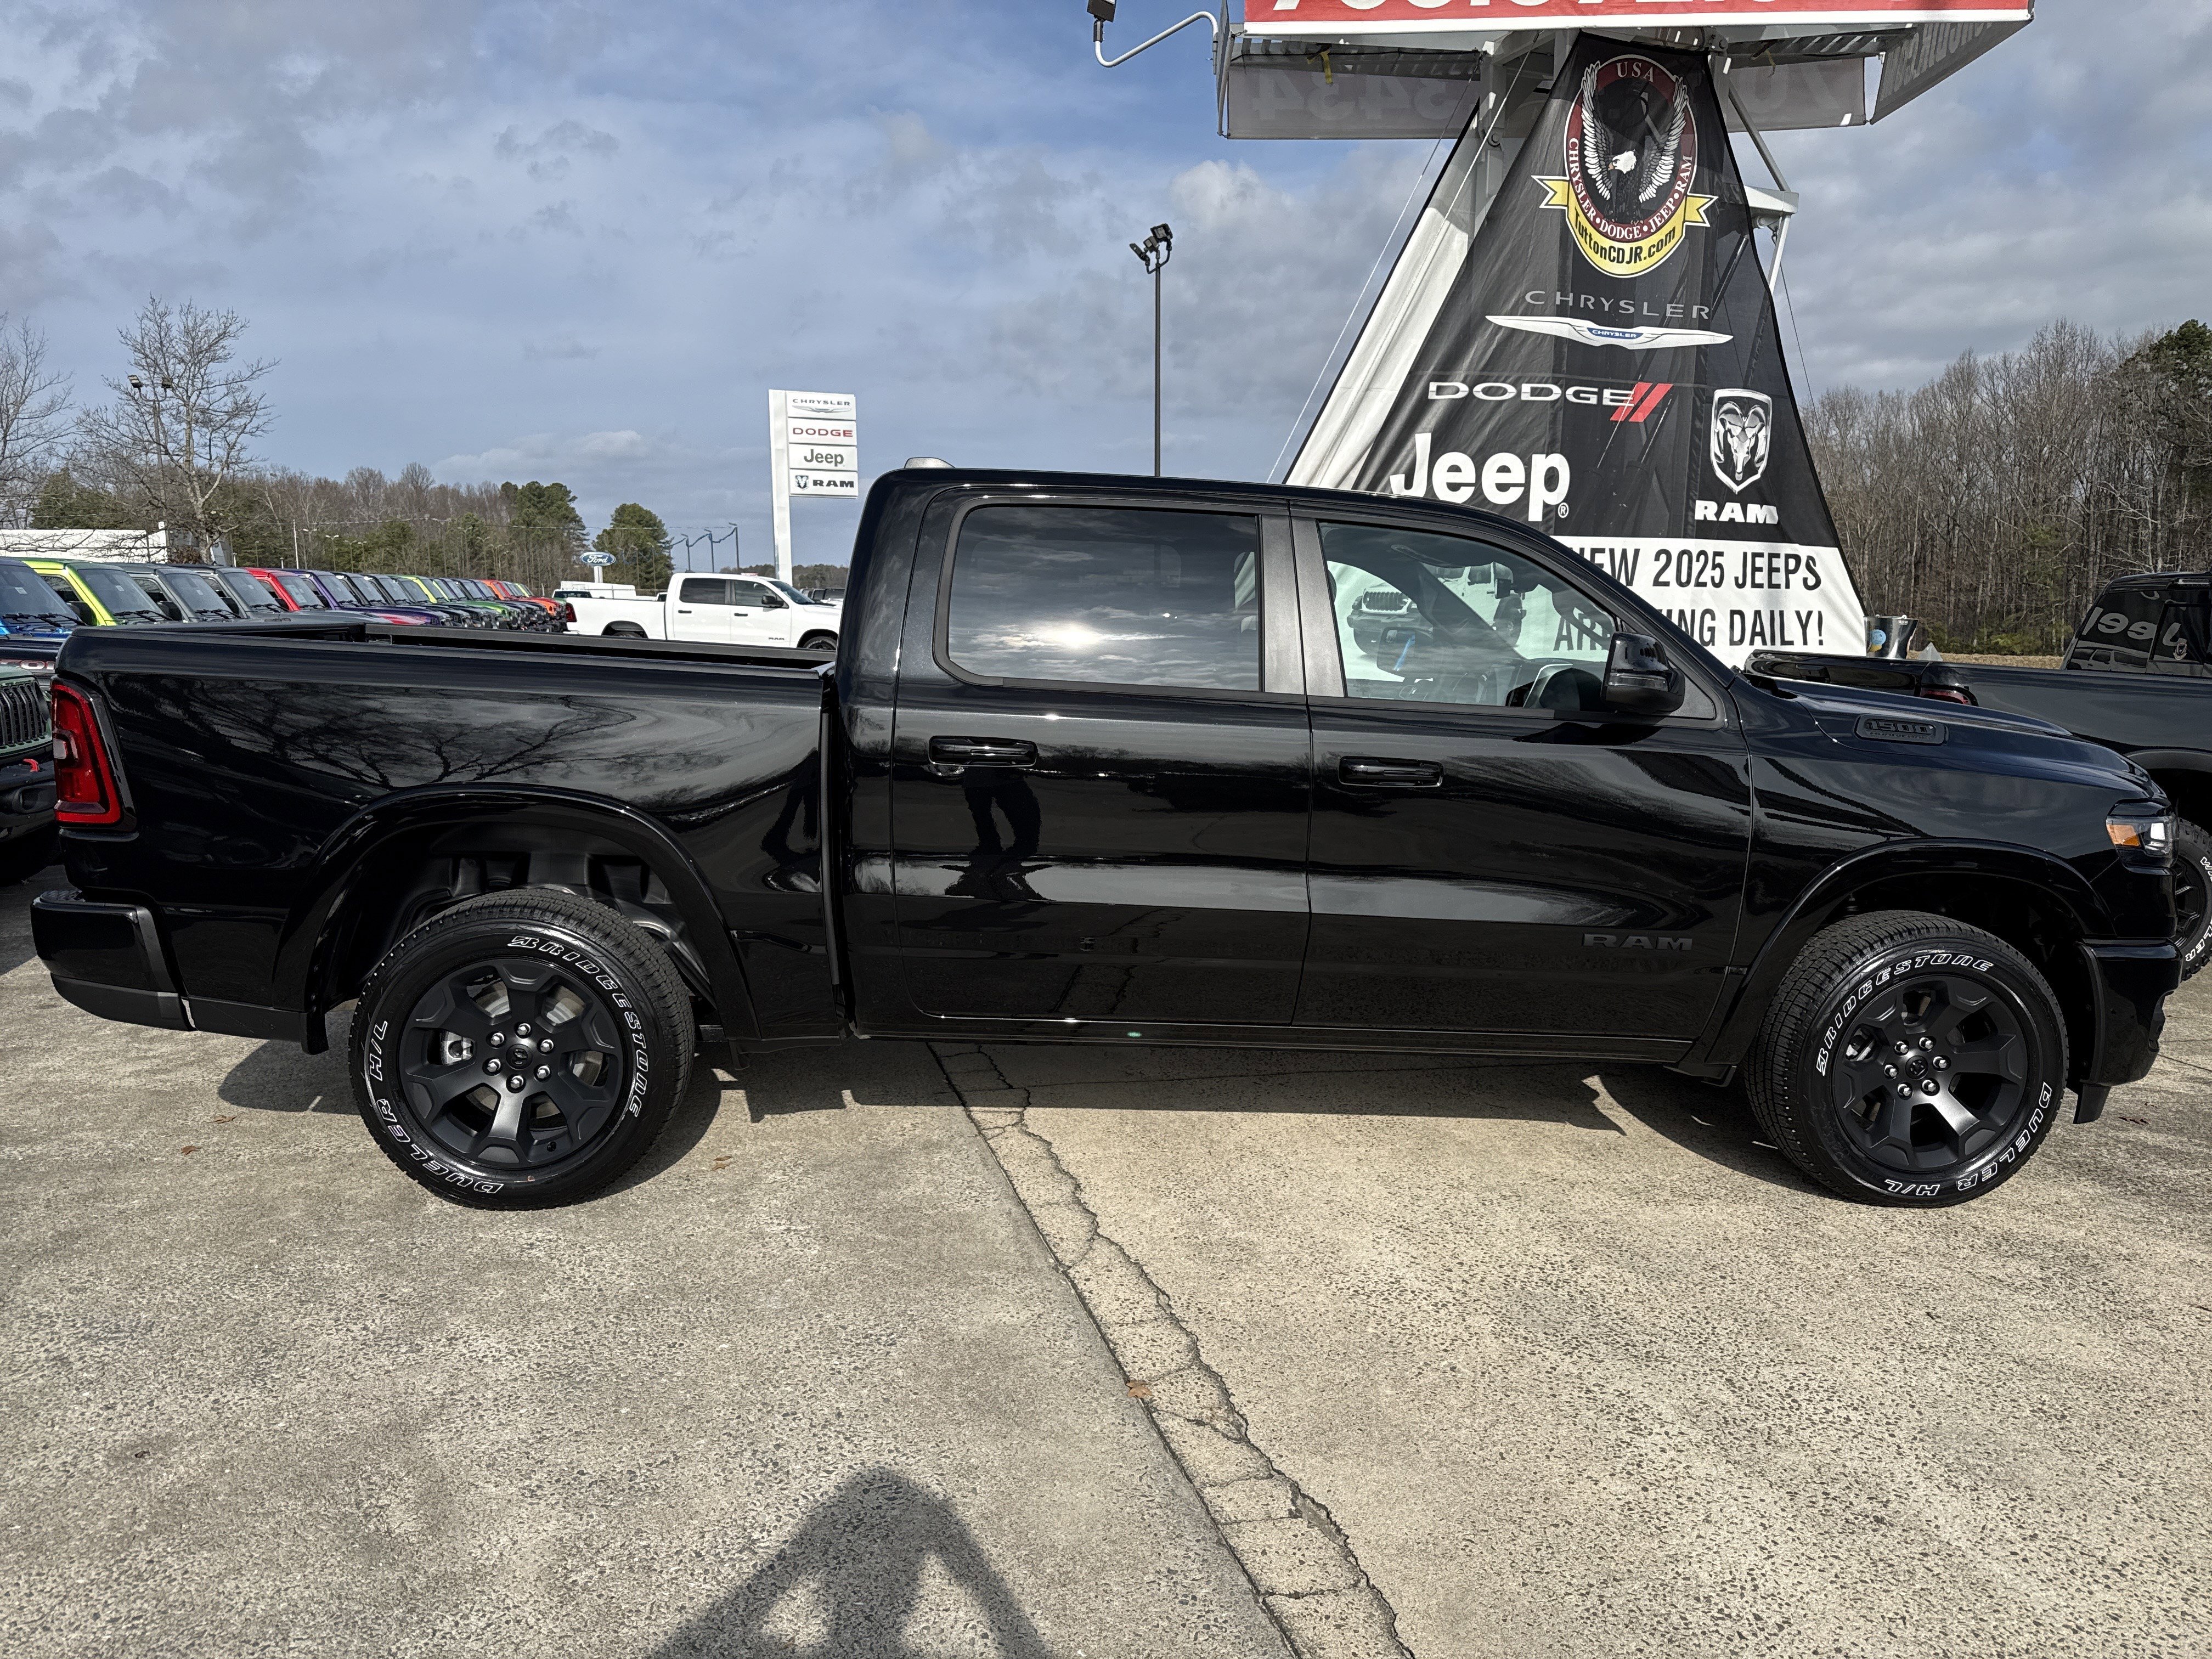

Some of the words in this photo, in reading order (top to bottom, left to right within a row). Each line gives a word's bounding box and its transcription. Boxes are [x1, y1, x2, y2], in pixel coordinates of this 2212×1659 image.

[1617, 61, 1654, 83] USA
[1569, 138, 1596, 224] CHRYSLER
[1599, 218, 1641, 240] DODGE
[1649, 197, 1676, 233] JEEP
[1675, 155, 1693, 196] RAM
[1525, 290, 1712, 320] CHRYSLER
[1592, 330, 1637, 338] CHRYSLER
[1427, 382, 1635, 408] DODGE
[792, 427, 853, 437] DODGE
[803, 449, 844, 467] Jeep
[812, 479, 854, 488] RAM
[1389, 432, 1570, 522] Jeep
[1694, 500, 1779, 525] RAM
[587, 555, 608, 563] Ford
[1652, 549, 1725, 589] 2025
[1734, 551, 1822, 591] JEEPS
[1729, 609, 1825, 646] DAILY!
[1865, 719, 1932, 735] 1500
[1582, 933, 1692, 951] RAM
[507, 935, 648, 1118] BRIDGESTONE
[1816, 954, 1994, 1076] BRIDGESTONE
[369, 1021, 388, 1081] H/L
[378, 1098, 504, 1194] DUELER
[1957, 1082, 2052, 1192] DUELER
[1885, 1179, 1940, 1196] H/L
